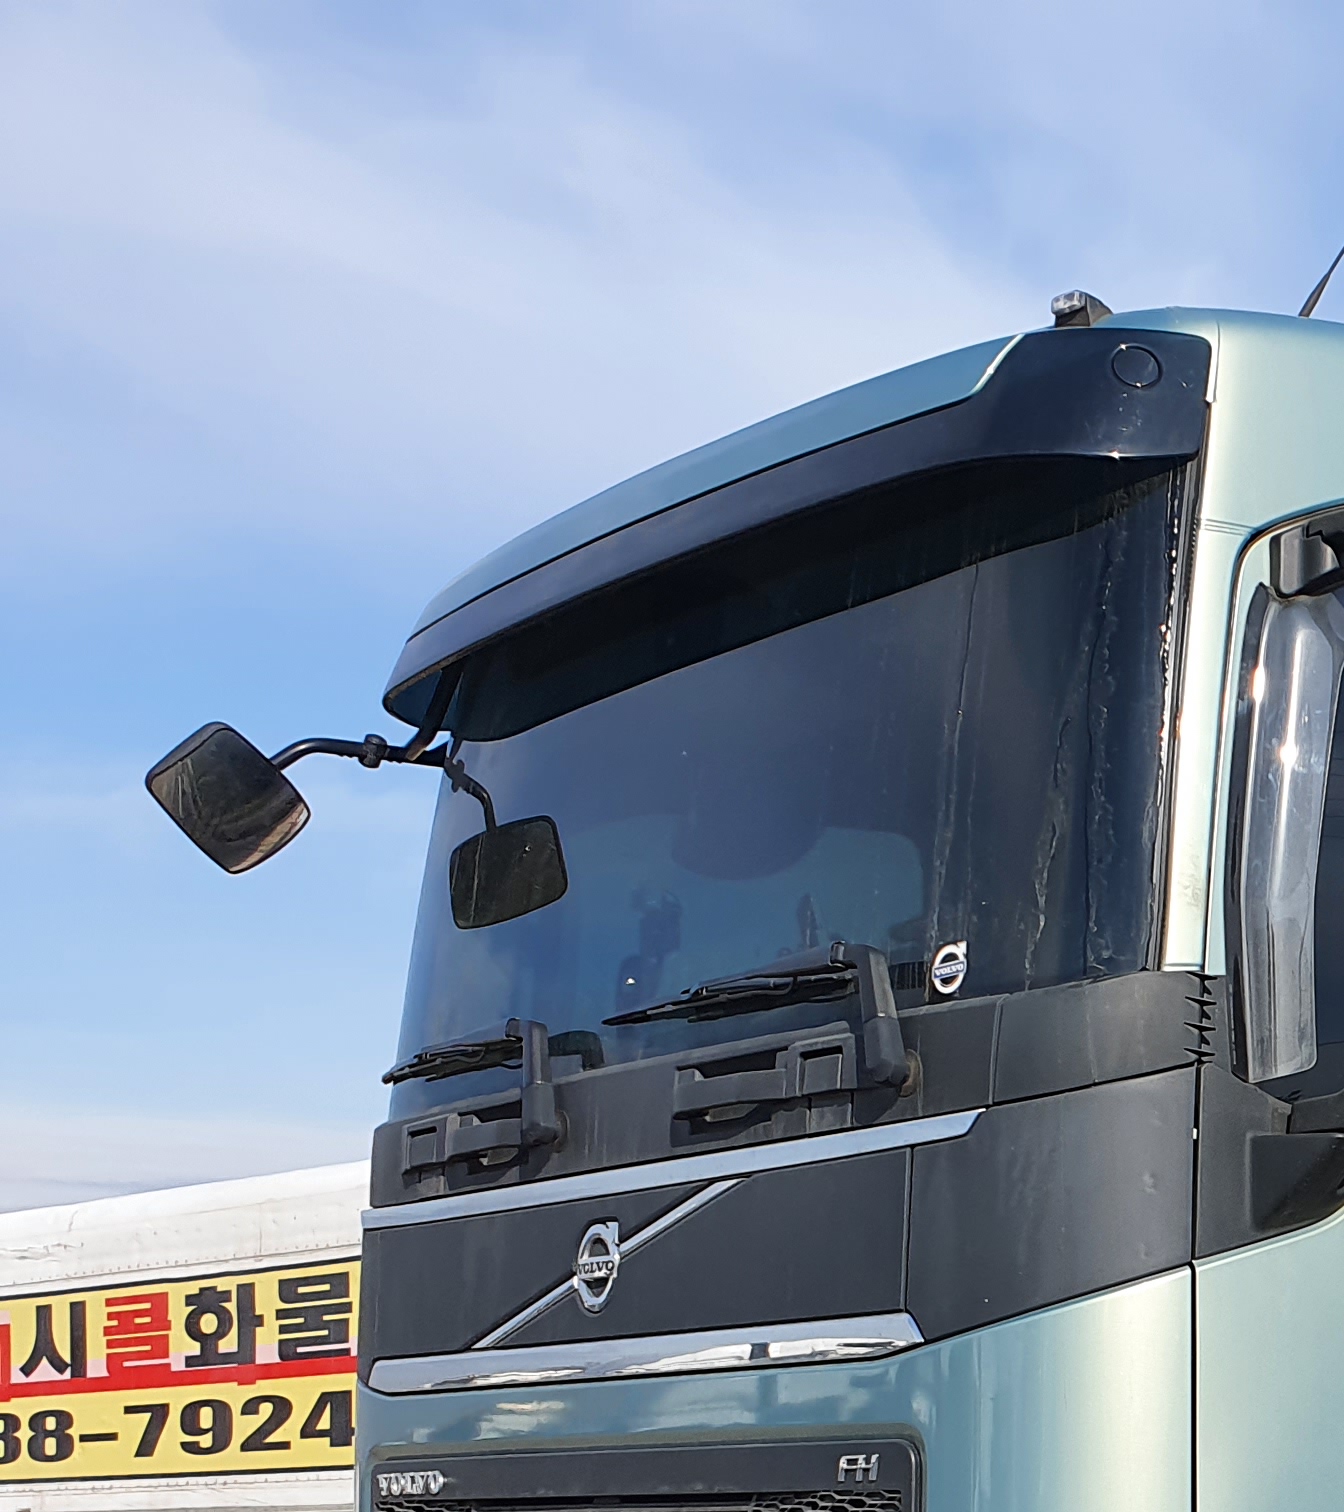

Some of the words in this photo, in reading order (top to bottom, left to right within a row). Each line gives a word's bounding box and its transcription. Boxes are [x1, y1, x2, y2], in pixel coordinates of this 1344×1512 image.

[934, 963, 964, 976] VOLVO
[578, 1259, 615, 1276] VOLVO
[0, 1271, 354, 1392] 시콜화물
[837, 1453, 880, 1482] FH
[377, 1470, 444, 1496] VOLVO
